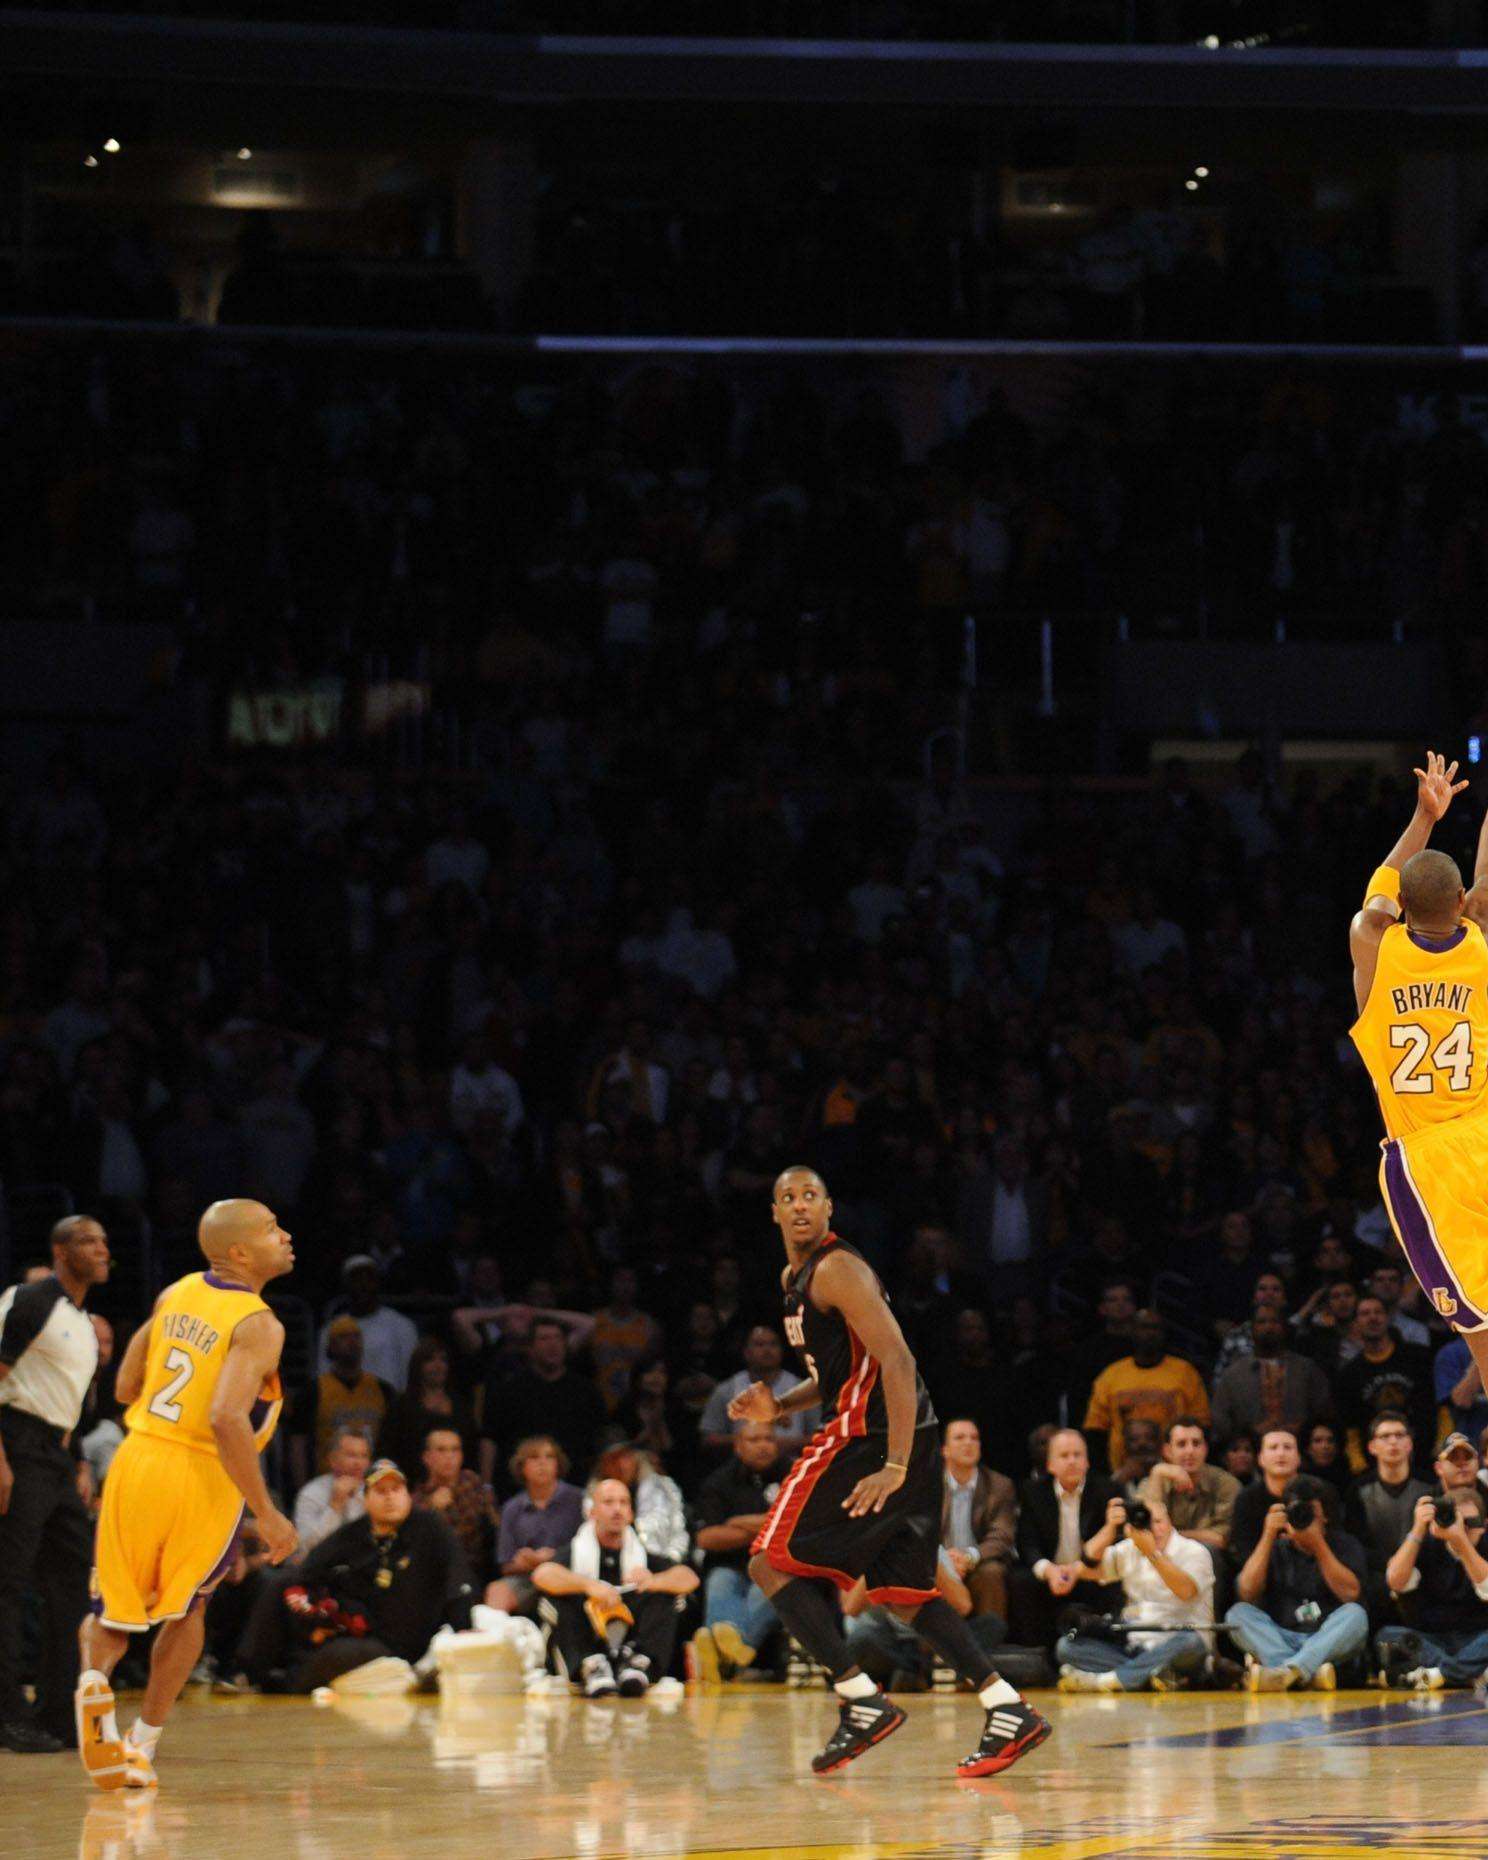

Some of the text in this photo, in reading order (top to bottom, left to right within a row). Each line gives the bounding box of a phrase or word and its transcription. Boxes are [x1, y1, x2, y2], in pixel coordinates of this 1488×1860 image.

[1391, 982, 1473, 1015] BRYANT
[1389, 1020, 1474, 1095] 24
[148, 1346, 196, 1424] 2
